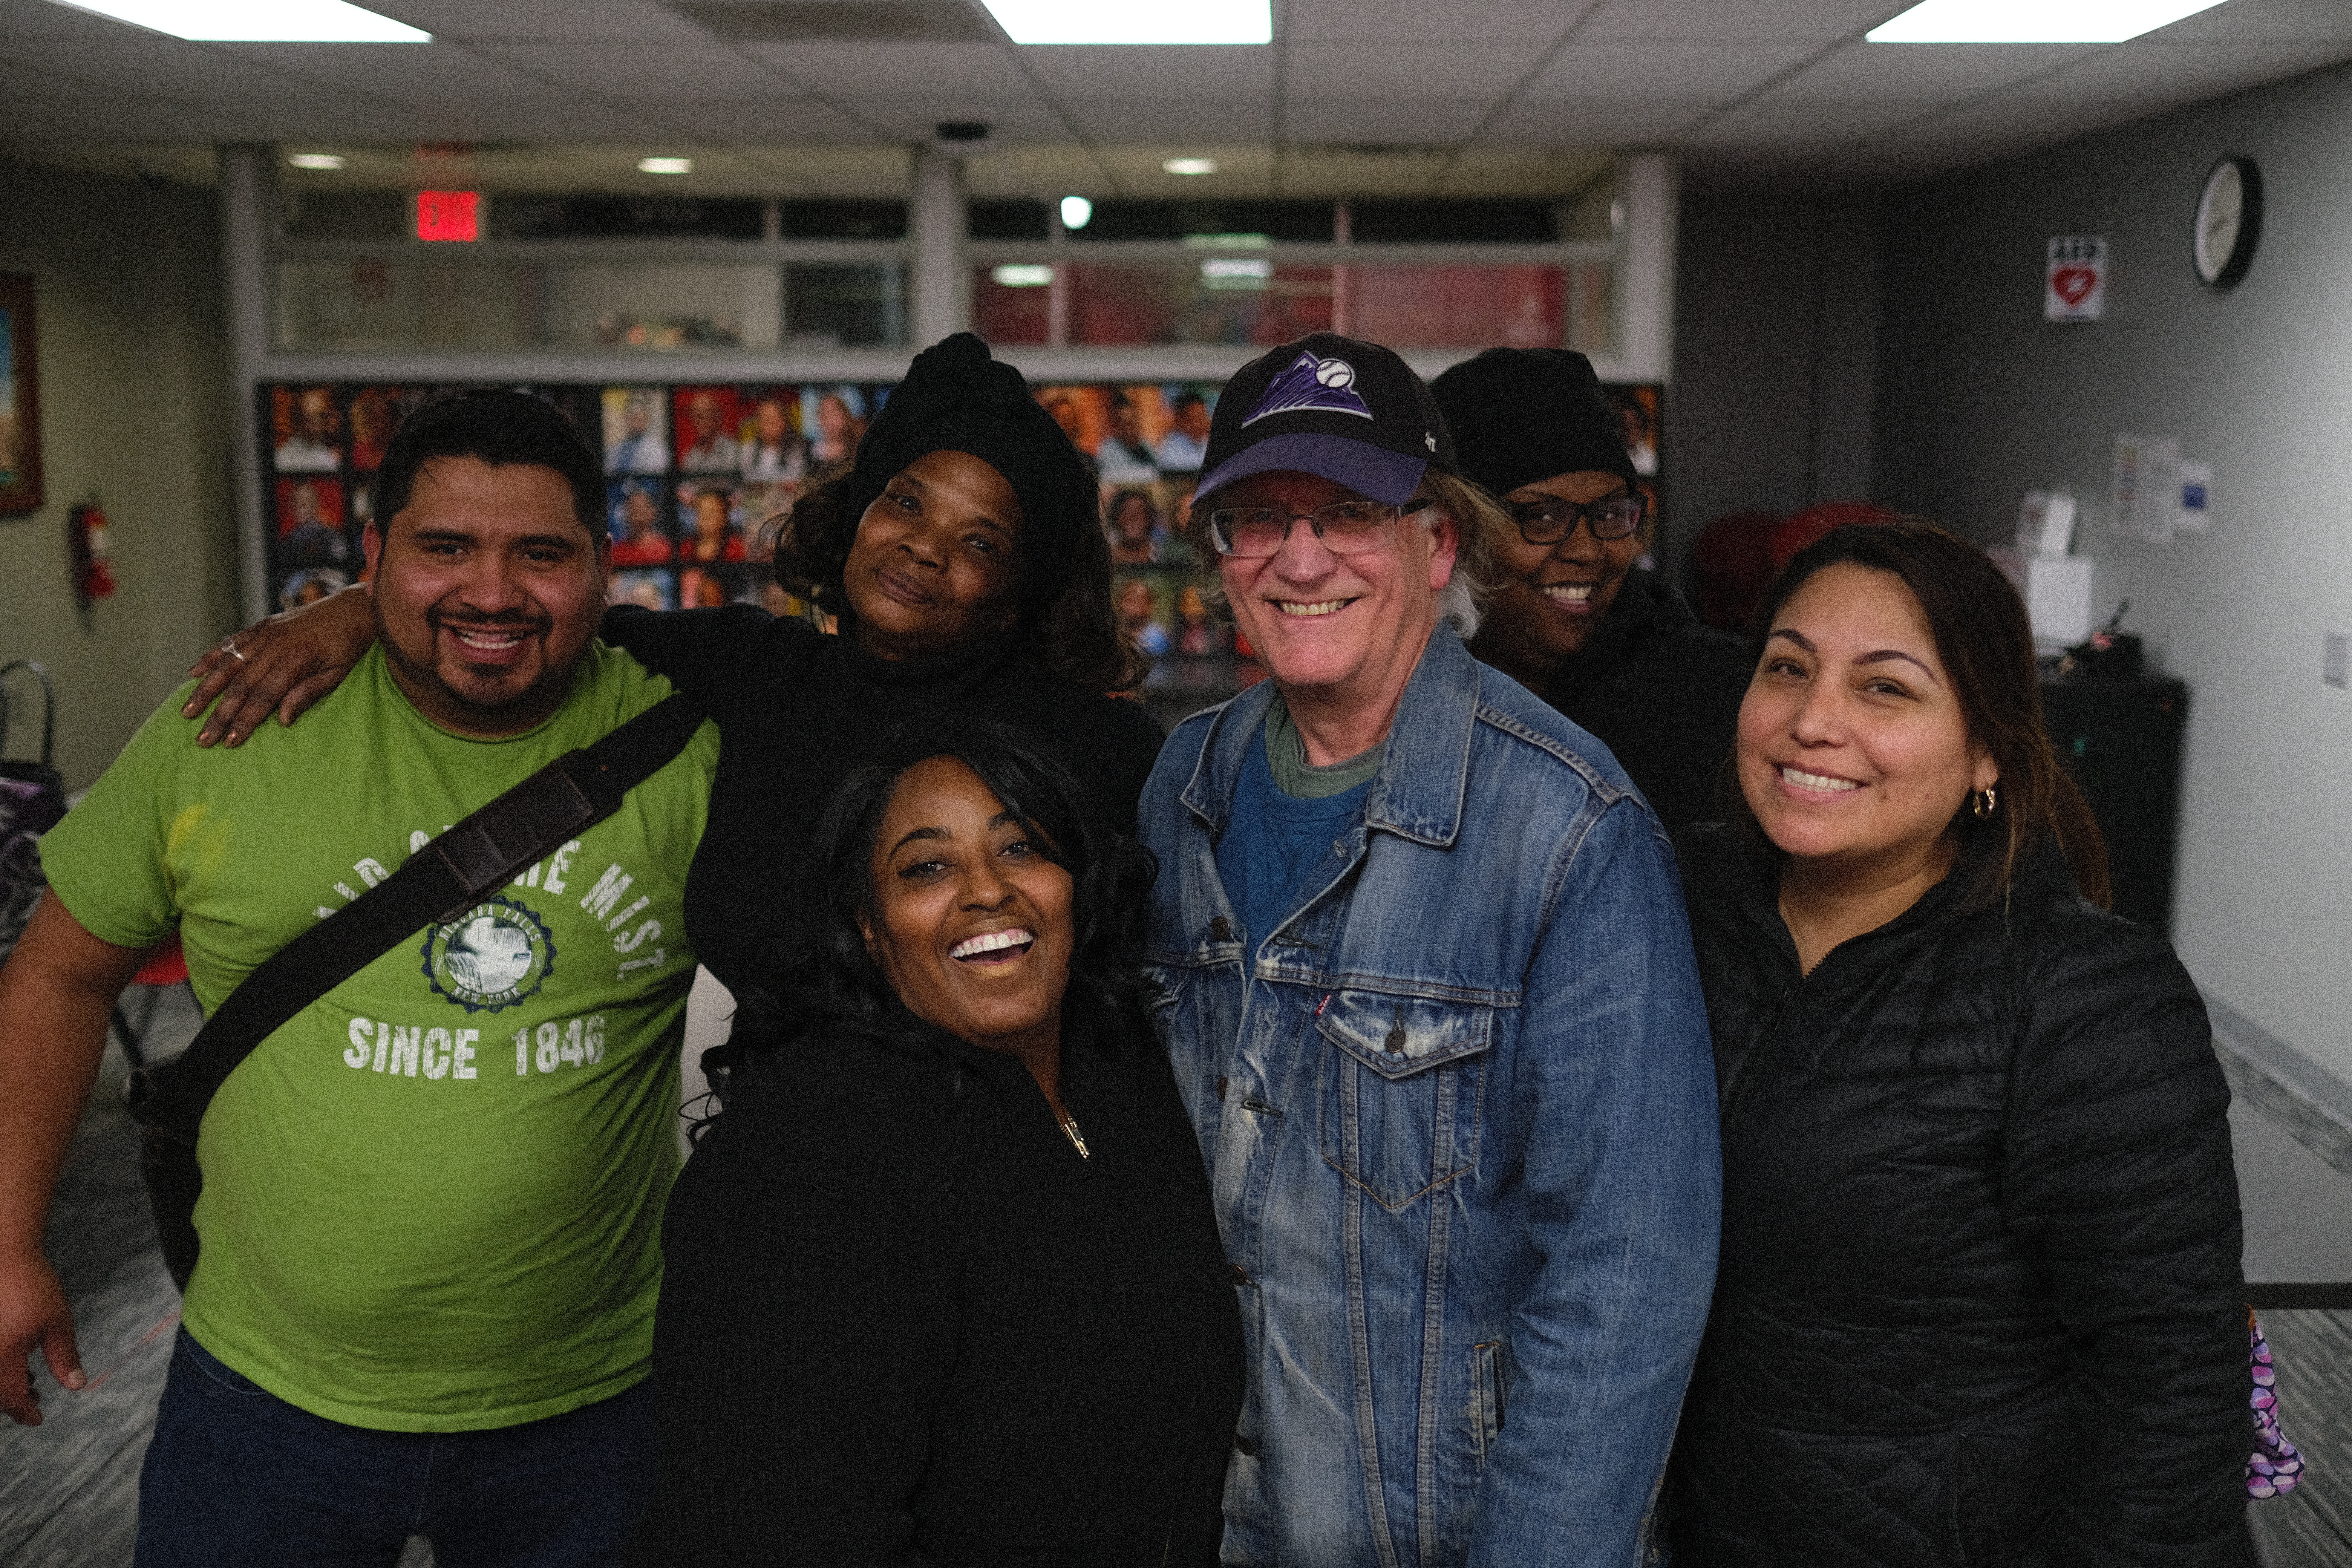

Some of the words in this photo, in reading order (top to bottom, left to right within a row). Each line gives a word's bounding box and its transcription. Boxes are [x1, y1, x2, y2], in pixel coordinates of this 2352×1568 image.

[439, 905, 493, 941] NIAGARA
[503, 908, 541, 942] FALLS
[452, 986, 481, 1003] NEW
[487, 986, 521, 1004] YORK
[343, 1017, 479, 1080] SINCE
[511, 1015, 605, 1076] 1846
